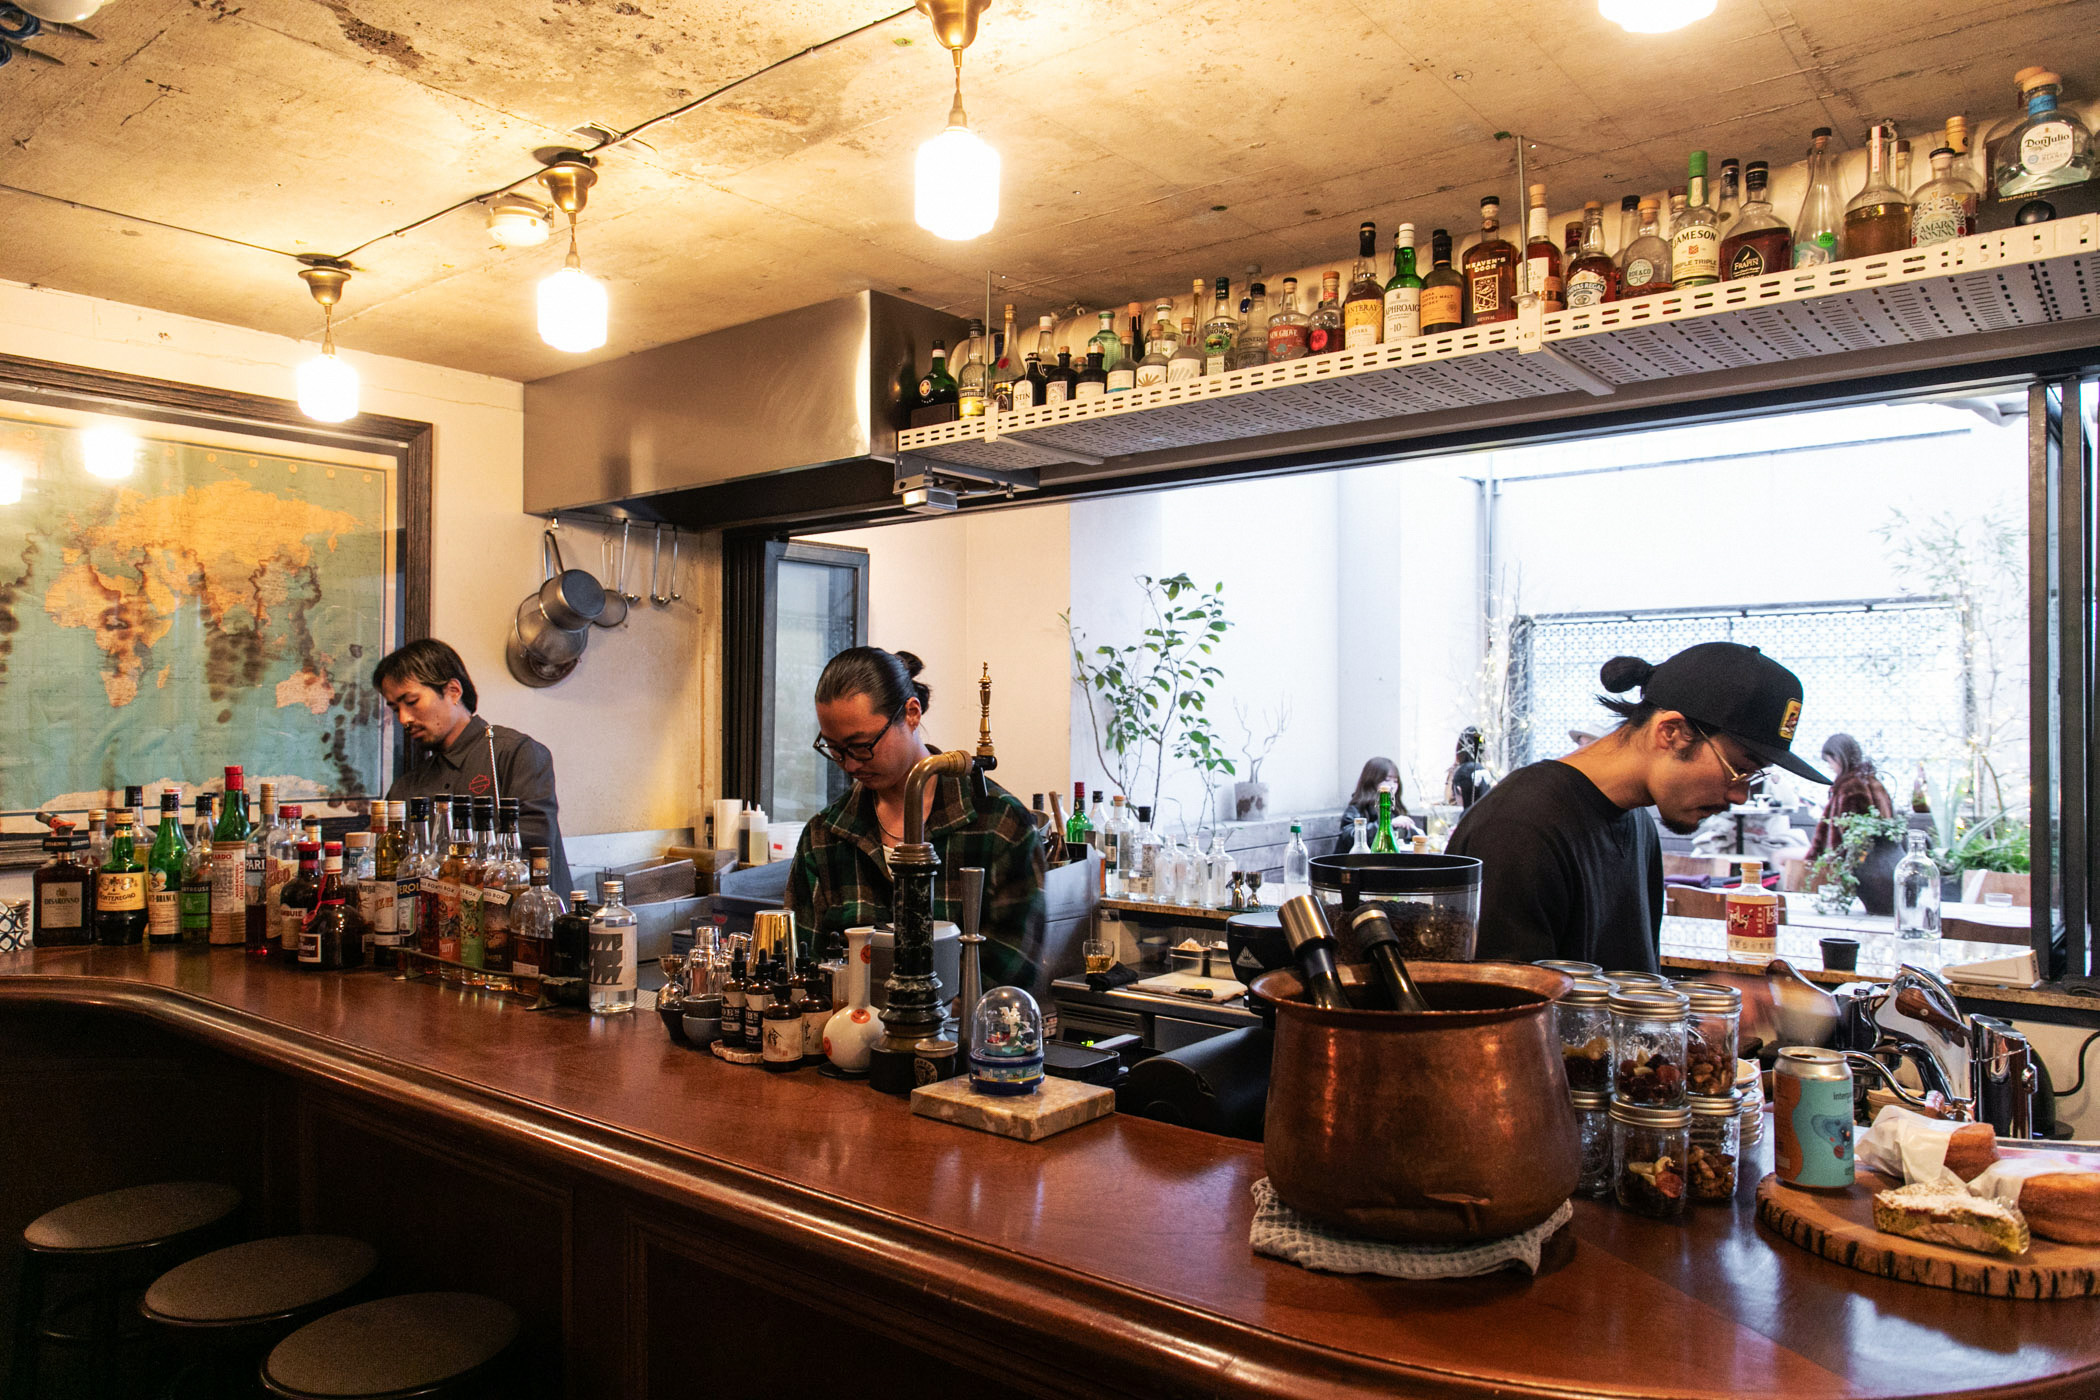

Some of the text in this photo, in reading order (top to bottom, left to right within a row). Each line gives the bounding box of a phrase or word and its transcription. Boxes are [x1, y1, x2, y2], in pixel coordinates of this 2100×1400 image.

[1920, 219, 1956, 233] AMARO
[1673, 229, 1718, 249] JAMESON
[1465, 256, 1506, 270] HEAVEN'S
[1694, 258, 1718, 266] TRIPLE
[1474, 263, 1497, 273] DOOR
[1585, 282, 1605, 292] REGAL
[1385, 303, 1420, 315] APHROAIG
[1279, 329, 1298, 337] GROVE
[1015, 393, 1031, 402] STIN
[397, 883, 420, 896] EROL
[44, 897, 80, 905] DISARONNO
[493, 892, 505, 900] BOX
